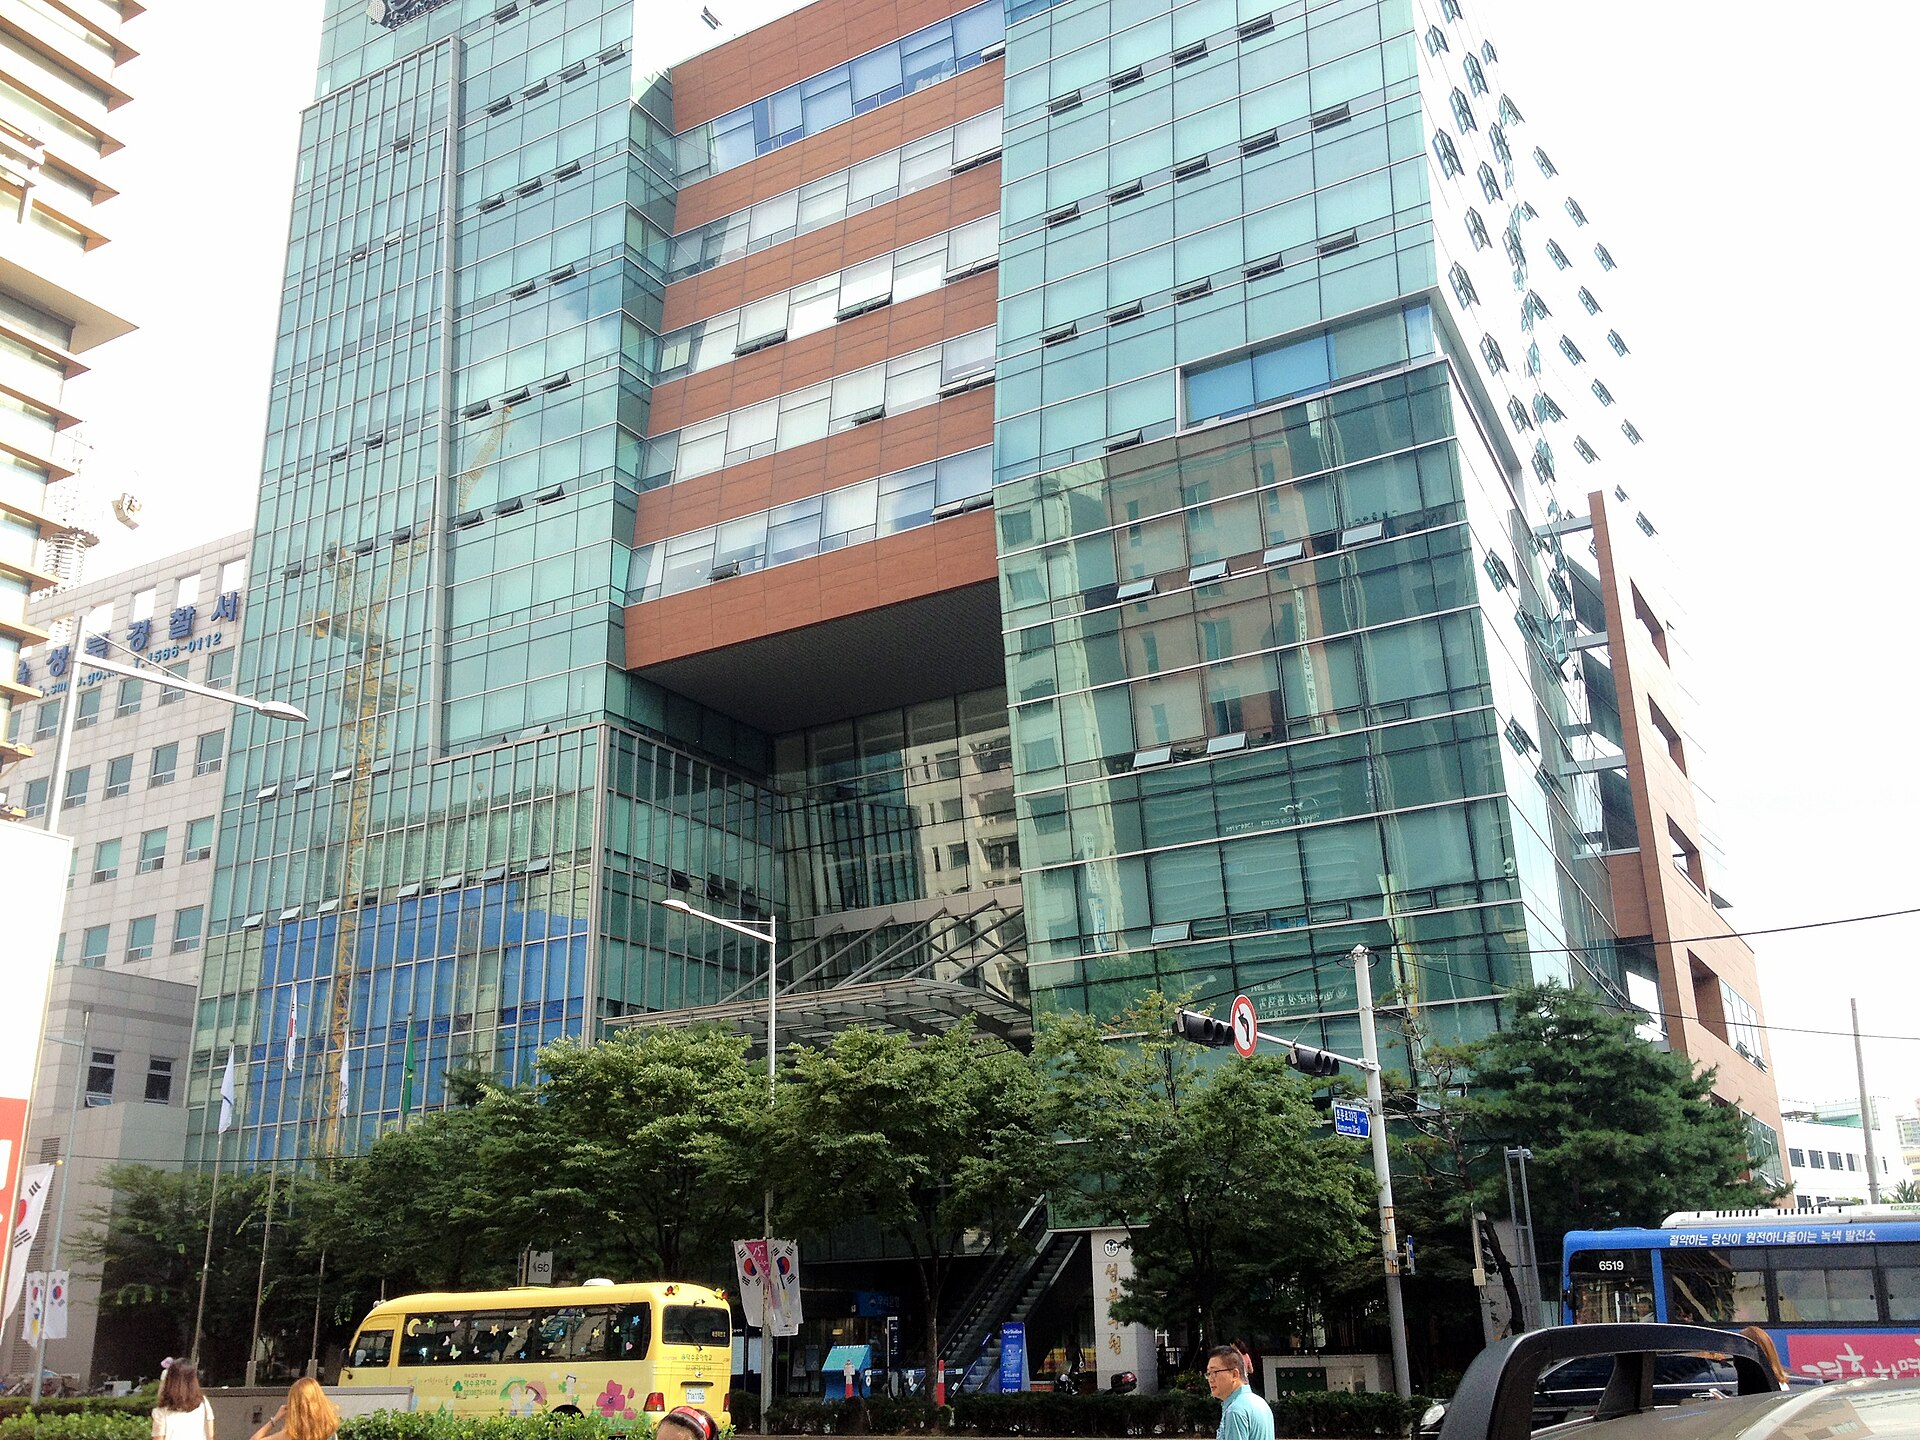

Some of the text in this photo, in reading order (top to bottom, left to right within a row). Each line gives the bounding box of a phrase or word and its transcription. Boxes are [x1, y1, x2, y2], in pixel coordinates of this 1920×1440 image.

[1711, 1233, 1741, 1245] 당신이
[1821, 1230, 1842, 1242] 녹색
[1845, 1229, 1876, 1241] 발전소
[1599, 1260, 1624, 1271] 6519
